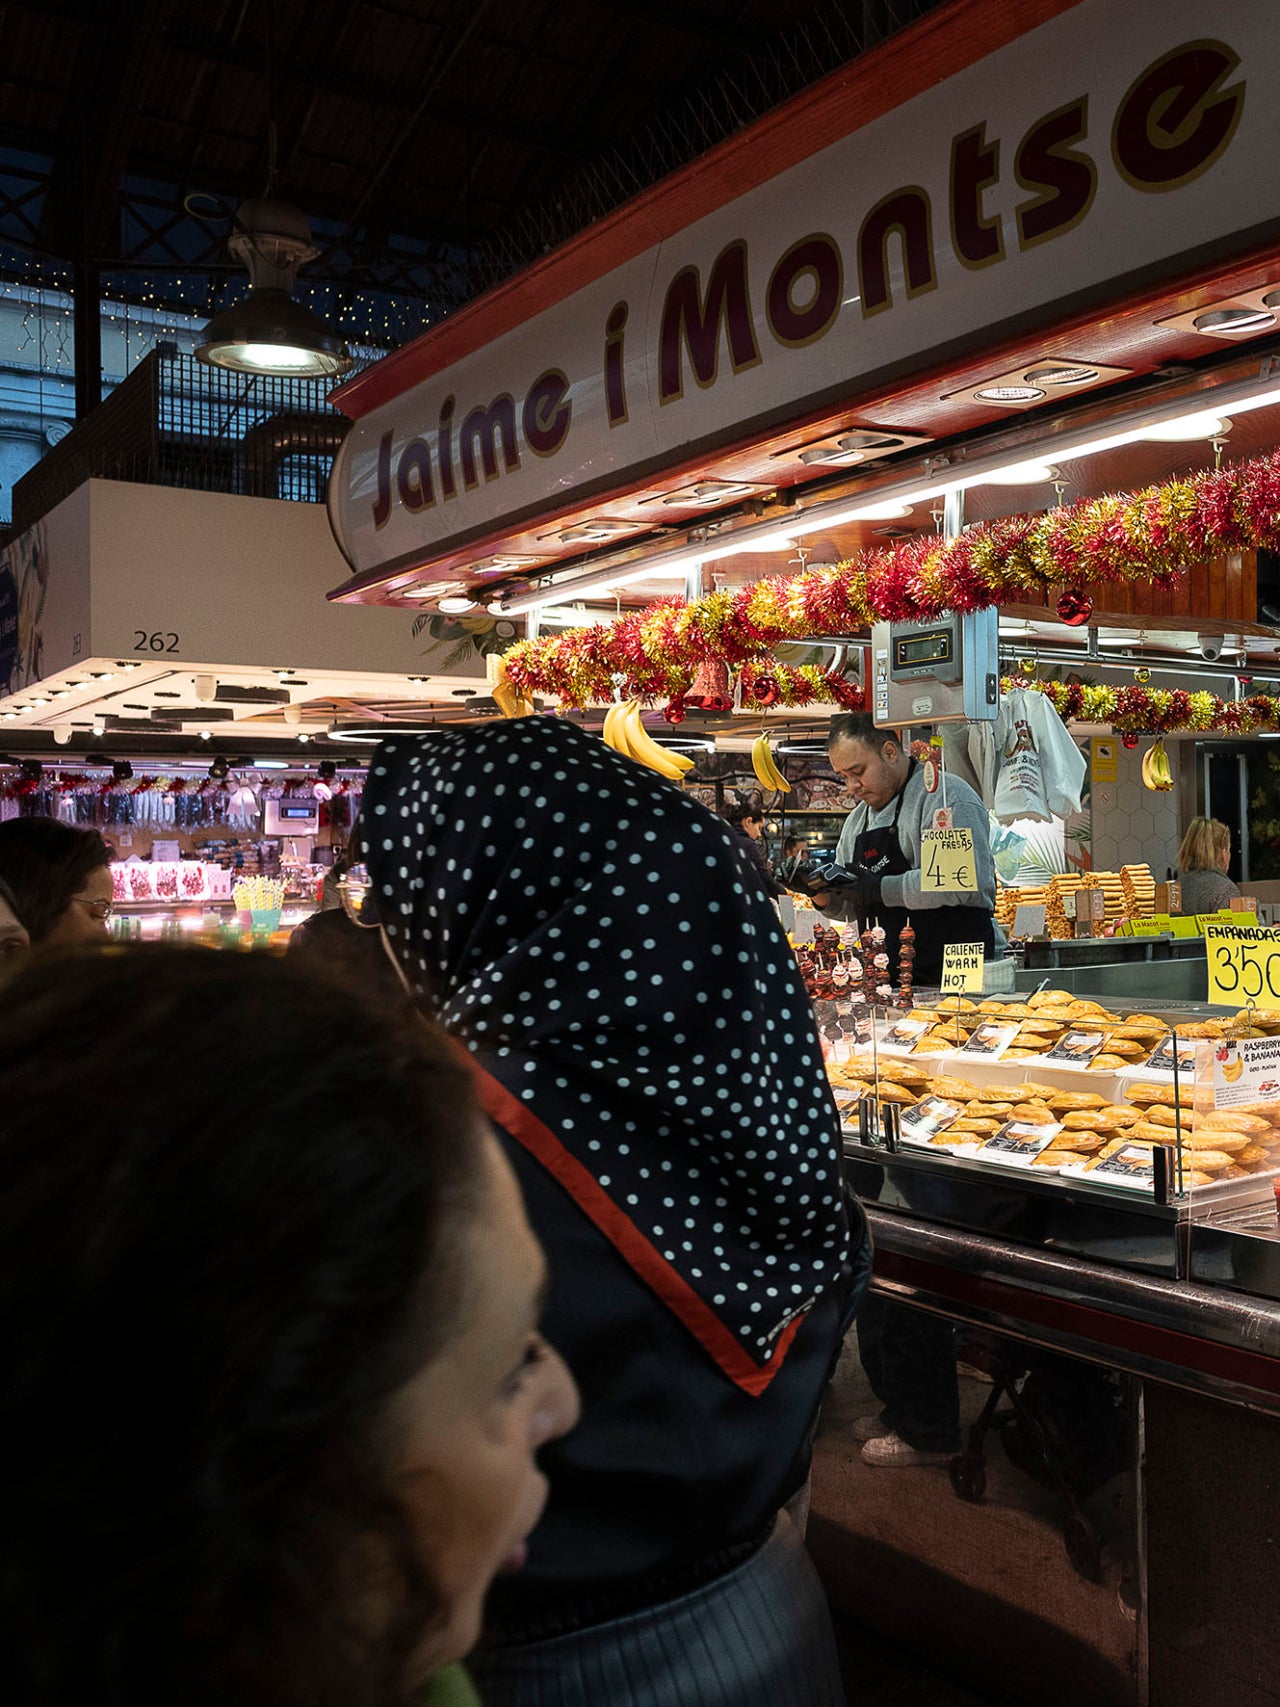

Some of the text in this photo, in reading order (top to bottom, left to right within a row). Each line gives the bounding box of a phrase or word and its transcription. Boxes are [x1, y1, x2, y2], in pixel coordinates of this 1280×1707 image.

[371, 37, 1247, 531] Jaime i Montse
[133, 631, 180, 654] 262
[941, 839, 973, 852] FRESAS
[945, 943, 985, 956] CALIENTE
[944, 973, 967, 988] HOT
[1243, 1053, 1250, 1062] &
